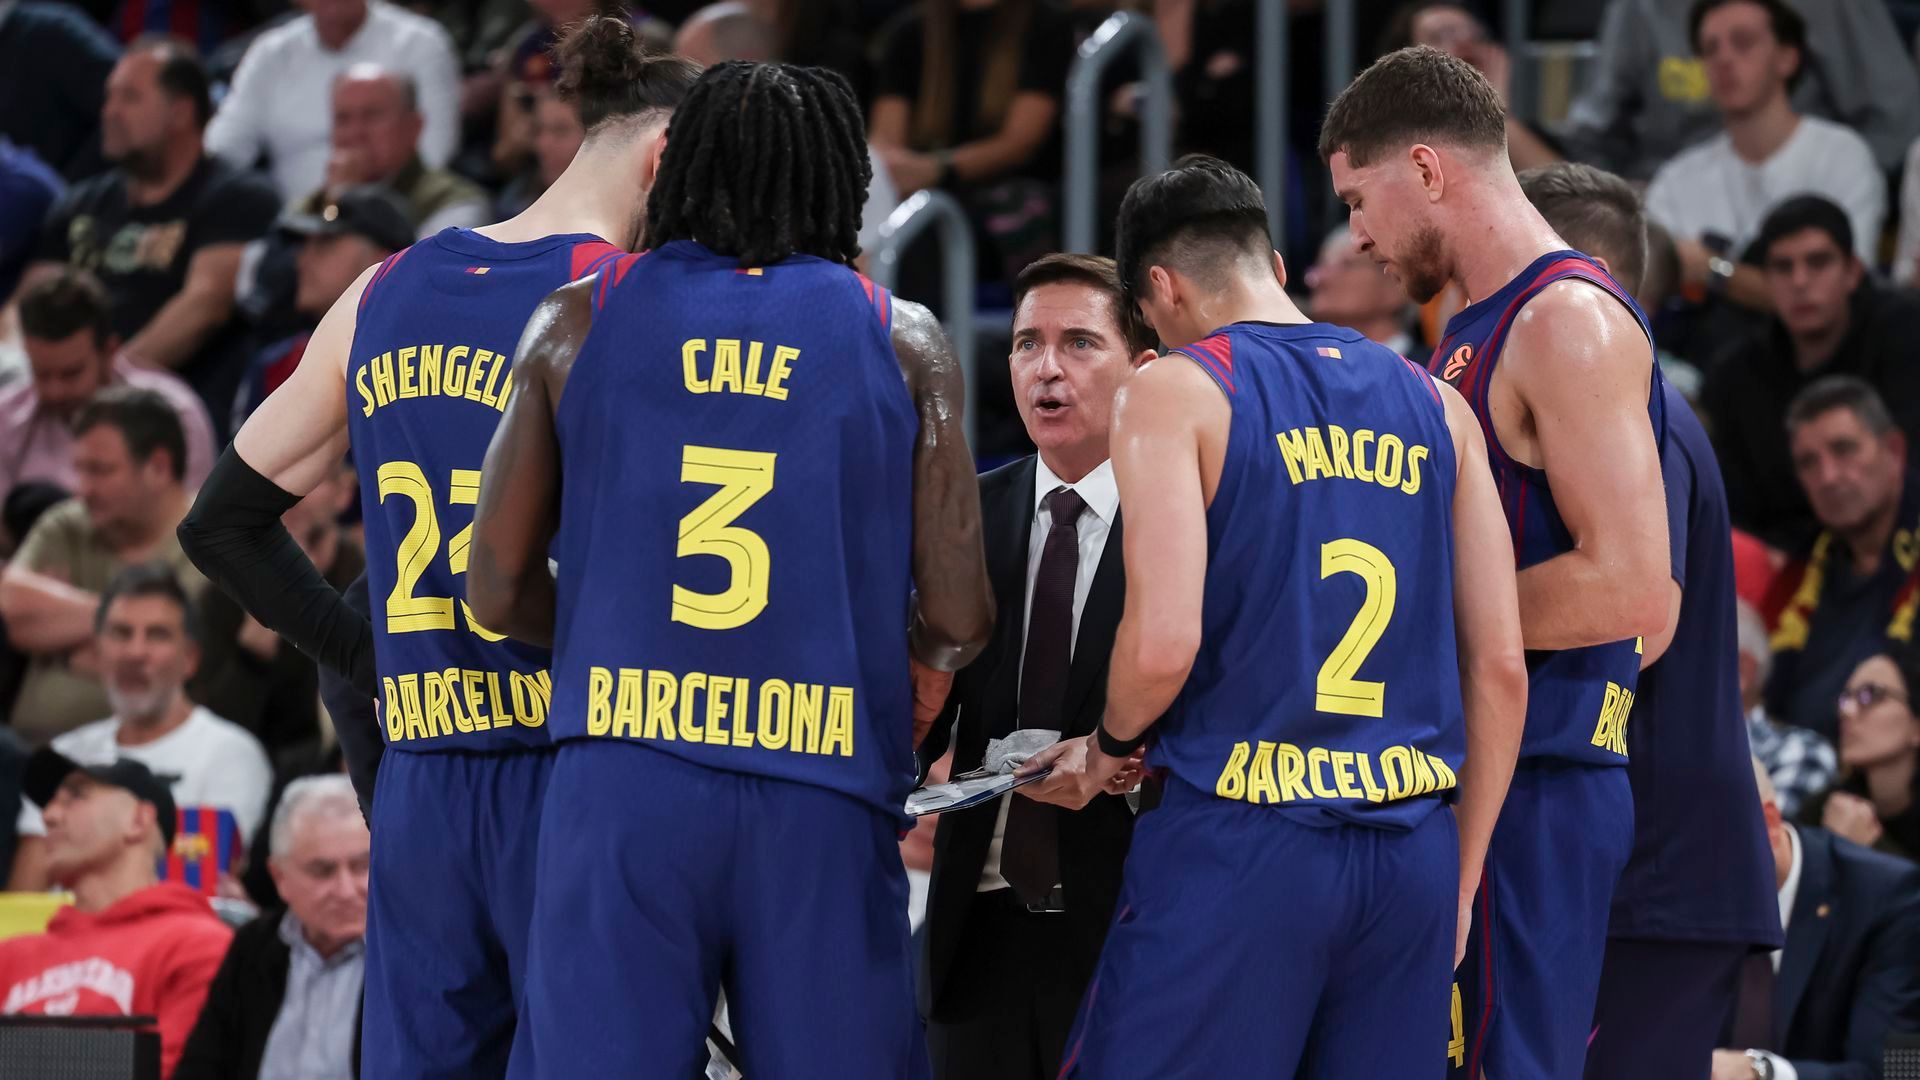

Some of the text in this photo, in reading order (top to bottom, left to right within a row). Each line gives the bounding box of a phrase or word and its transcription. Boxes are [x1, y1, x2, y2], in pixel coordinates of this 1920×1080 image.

[681, 338, 801, 401] CALE
[1276, 424, 1429, 496] MARCOS
[671, 444, 778, 630] 3
[1315, 537, 1397, 718] 2
[587, 666, 854, 757] BARCELONA
[1216, 740, 1458, 804] BARCELONA
